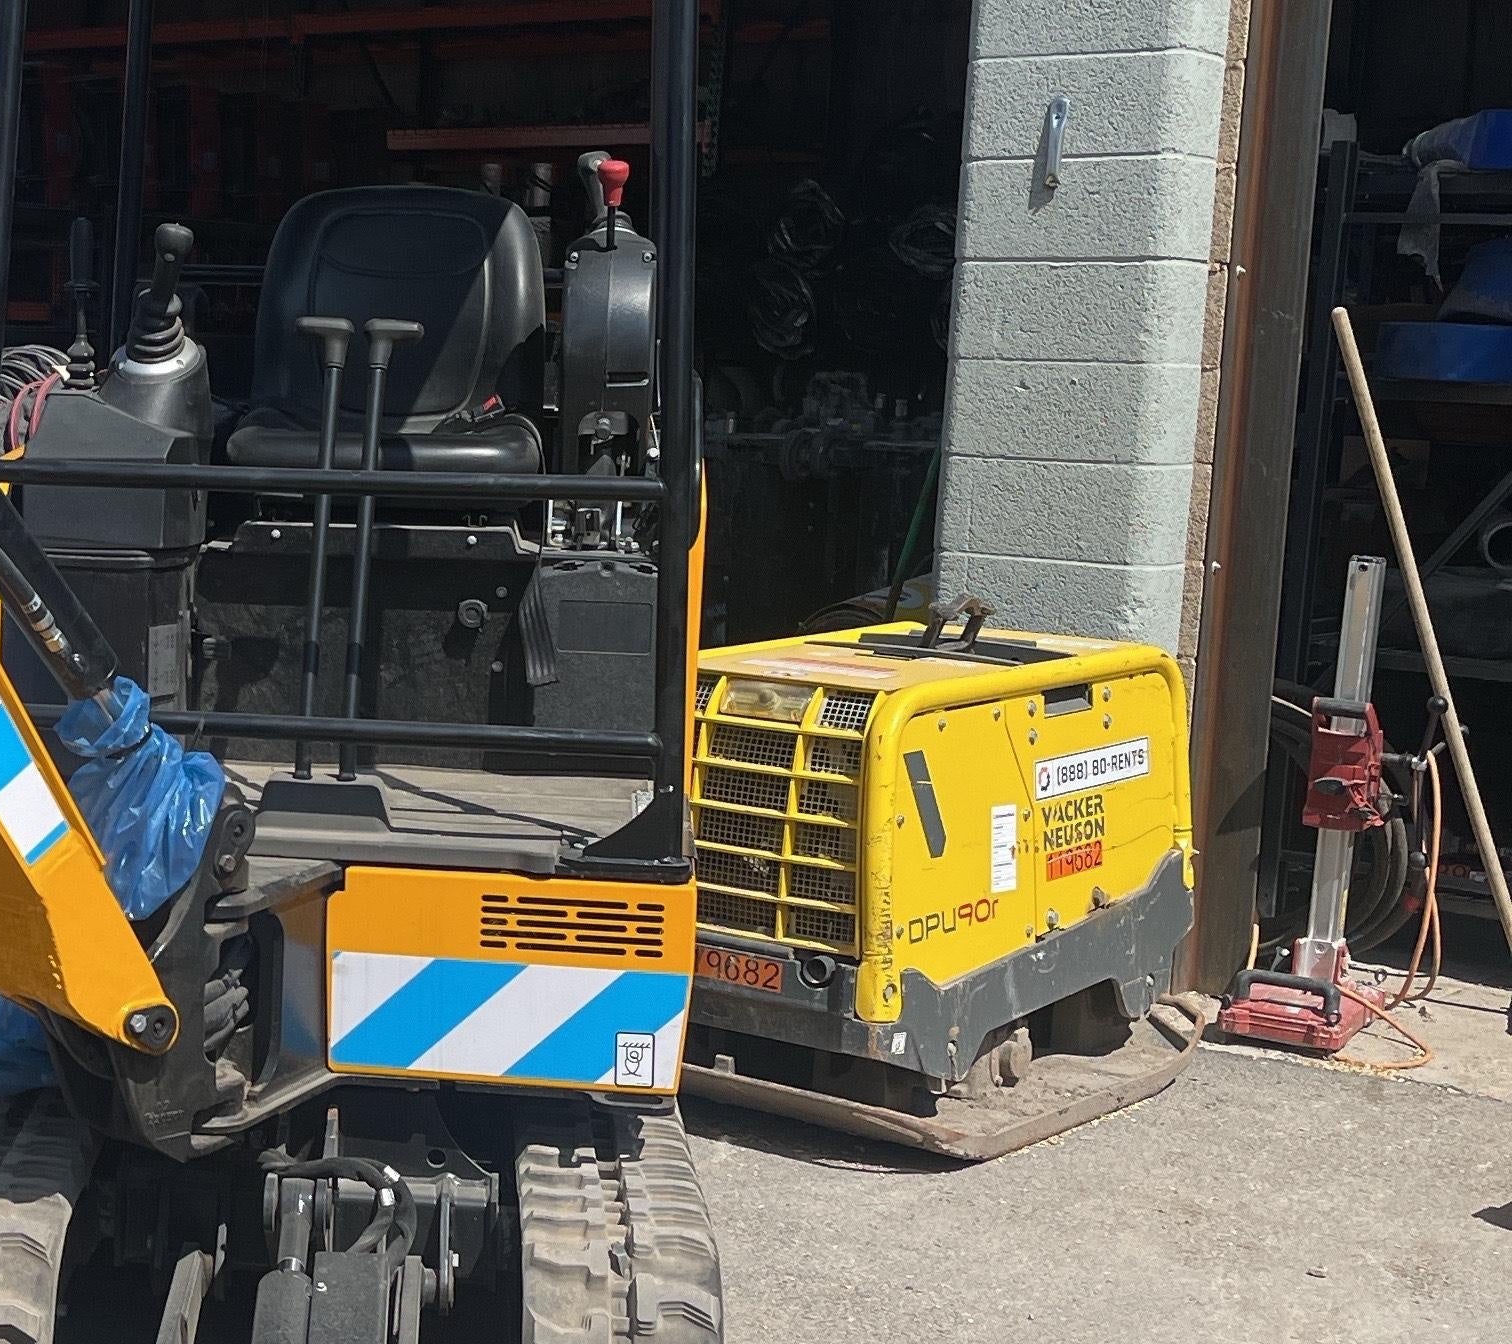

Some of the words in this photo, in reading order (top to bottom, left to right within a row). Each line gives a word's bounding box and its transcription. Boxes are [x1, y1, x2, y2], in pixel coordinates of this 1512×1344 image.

[1055, 755, 1090, 788] (888)
[1090, 746, 1147, 780] 80-RENTS
[1040, 793, 1105, 828] WACKER
[1042, 819, 1106, 851] NEUSON
